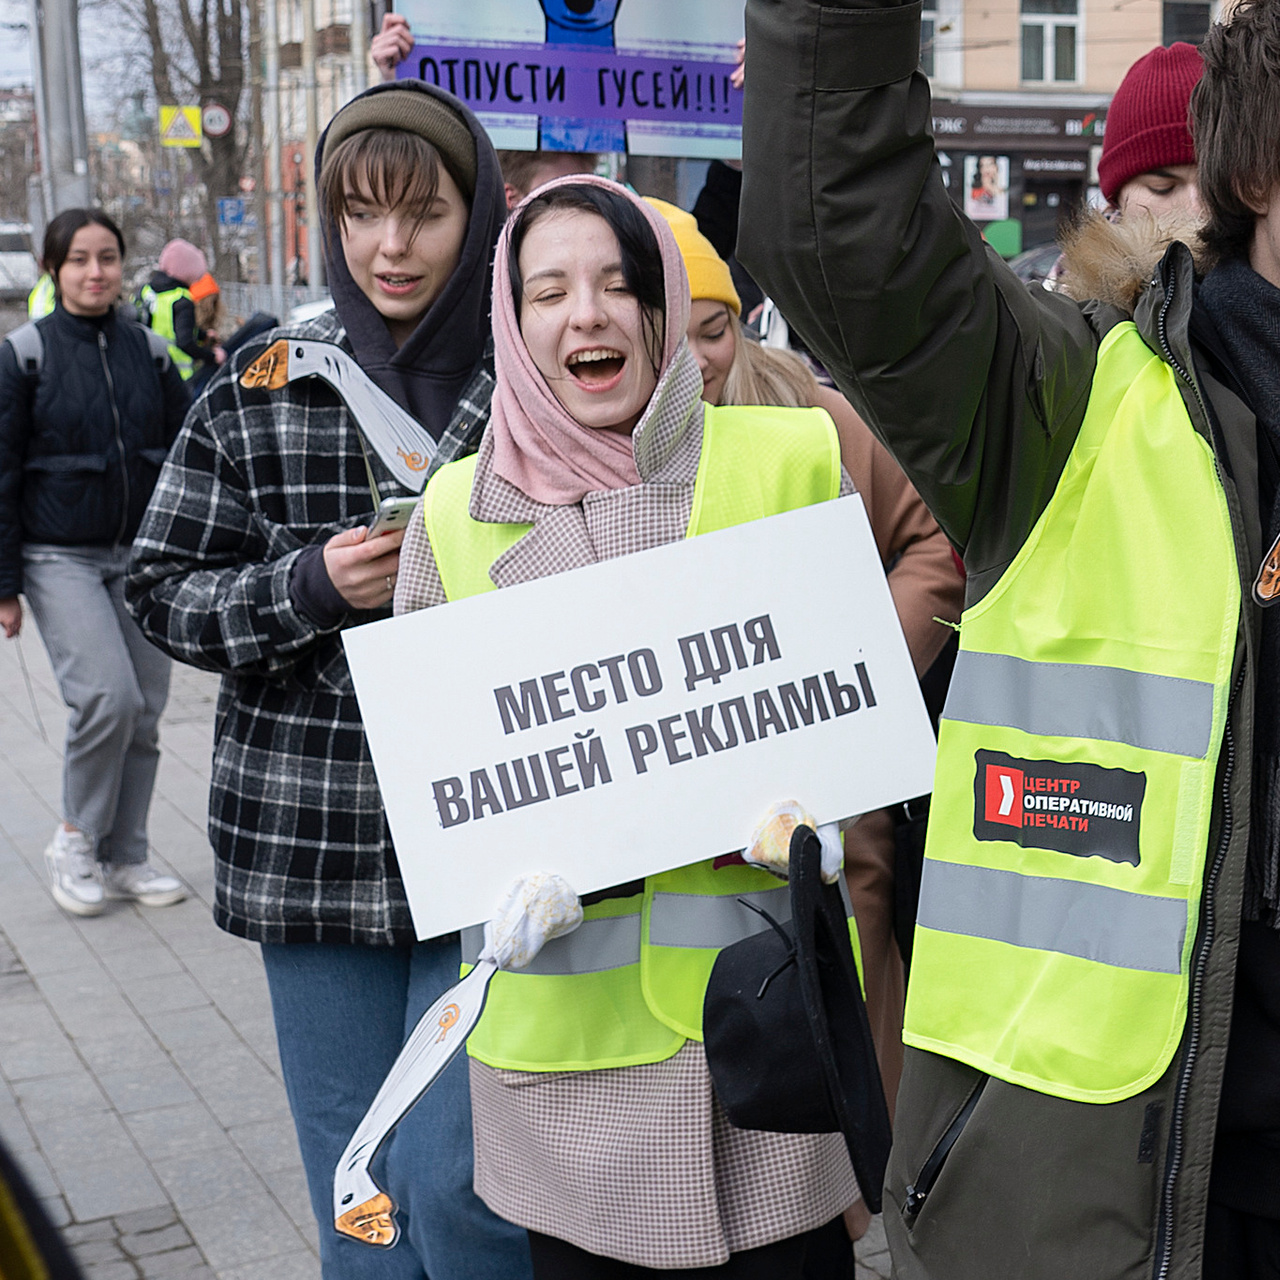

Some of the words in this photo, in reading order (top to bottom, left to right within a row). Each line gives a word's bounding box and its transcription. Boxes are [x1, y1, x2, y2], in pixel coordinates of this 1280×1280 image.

[418, 57, 566, 103] ОТПУСТИ
[597, 65, 730, 113] ГУСЕЙ!!!
[492, 647, 663, 736] МЕСТО
[676, 613, 783, 693] ДЛЯ
[430, 728, 613, 830] ВАШЕЙ
[624, 660, 878, 776] РЕКЛАМЫ
[1024, 776, 1081, 794] ЦЕНТР
[1023, 794, 1134, 823] ОПЕРАТИВНОЙ
[1023, 812, 1089, 833] ПЕЧАТИ
